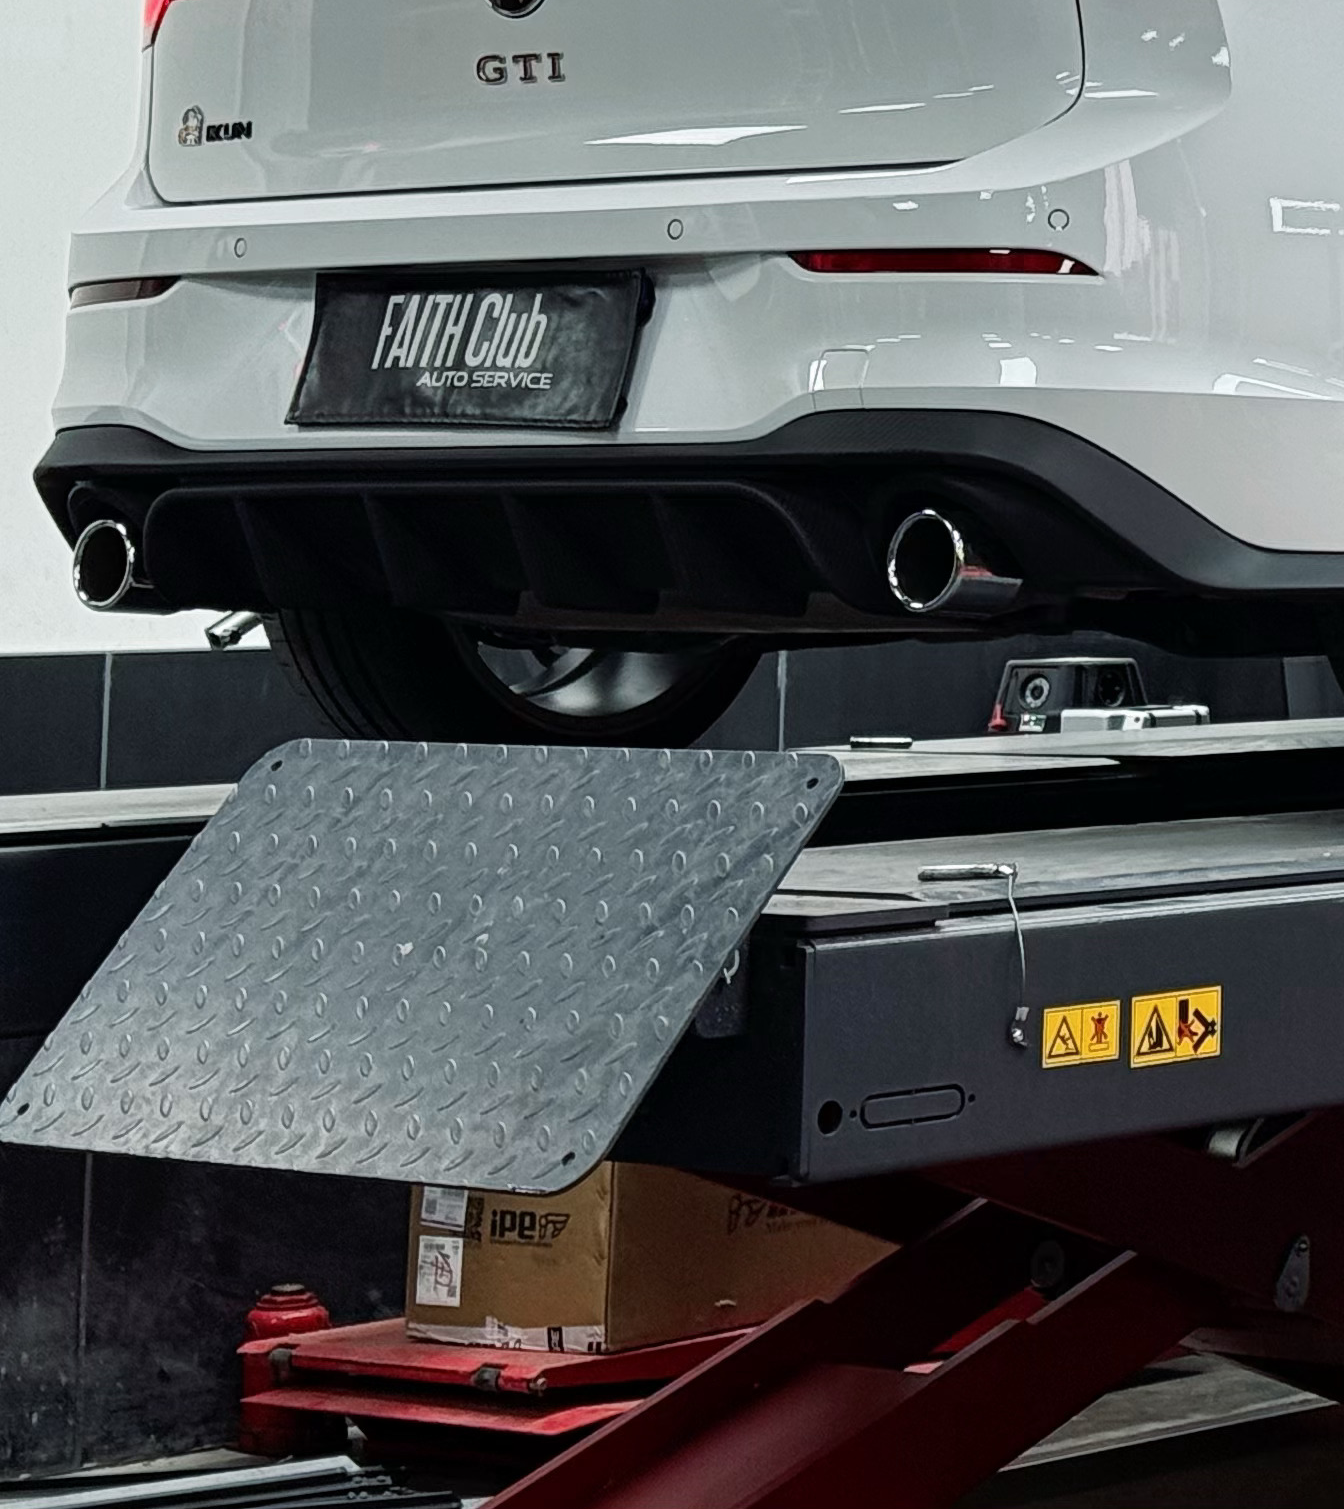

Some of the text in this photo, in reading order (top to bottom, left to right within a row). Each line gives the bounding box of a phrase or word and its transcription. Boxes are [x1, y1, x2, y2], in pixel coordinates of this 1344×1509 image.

[475, 52, 567, 85] GTI
[371, 292, 548, 370] FAITH Club
[415, 370, 554, 390] AUTO SERVICE
